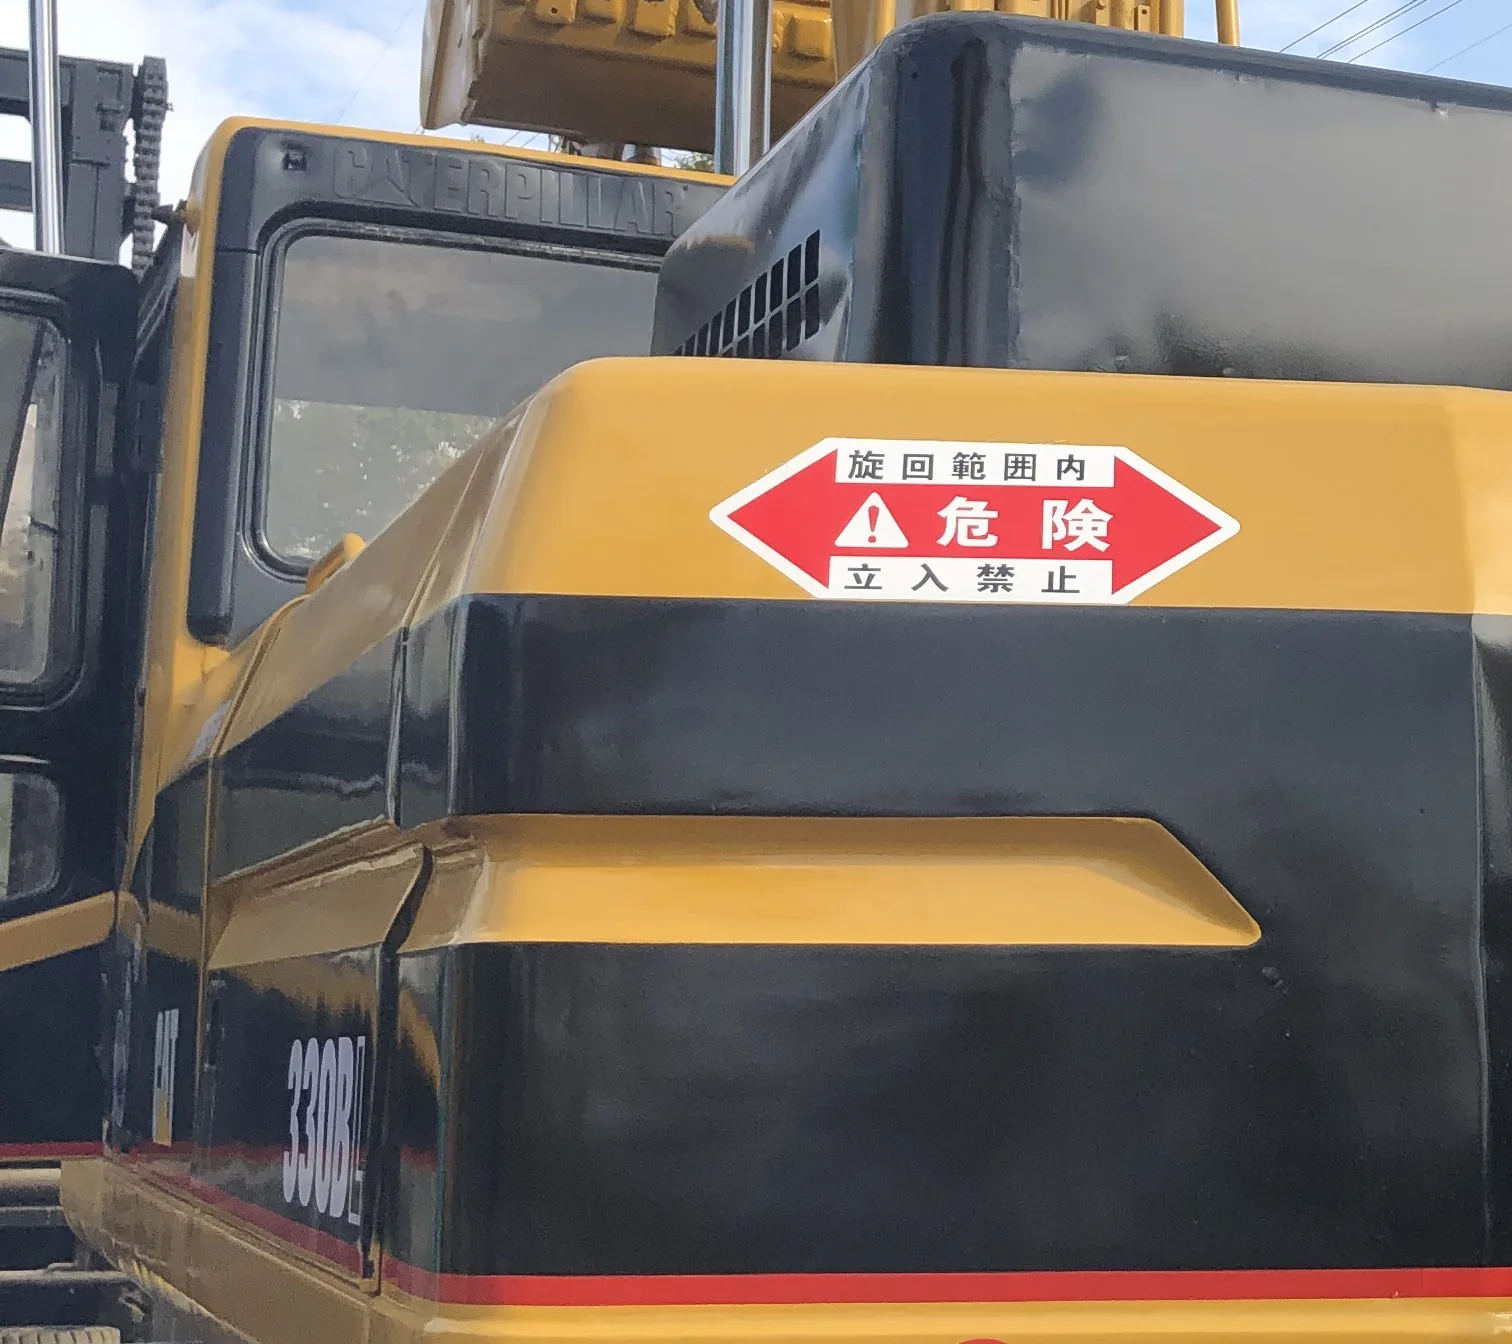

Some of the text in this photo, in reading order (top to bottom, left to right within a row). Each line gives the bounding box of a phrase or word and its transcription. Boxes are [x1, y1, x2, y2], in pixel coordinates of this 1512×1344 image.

[332, 144, 684, 237] CATERPILLAR
[848, 450, 1086, 481] 旋回範囲内
[936, 496, 1114, 552] 危険
[844, 563, 1080, 593] 立入禁止
